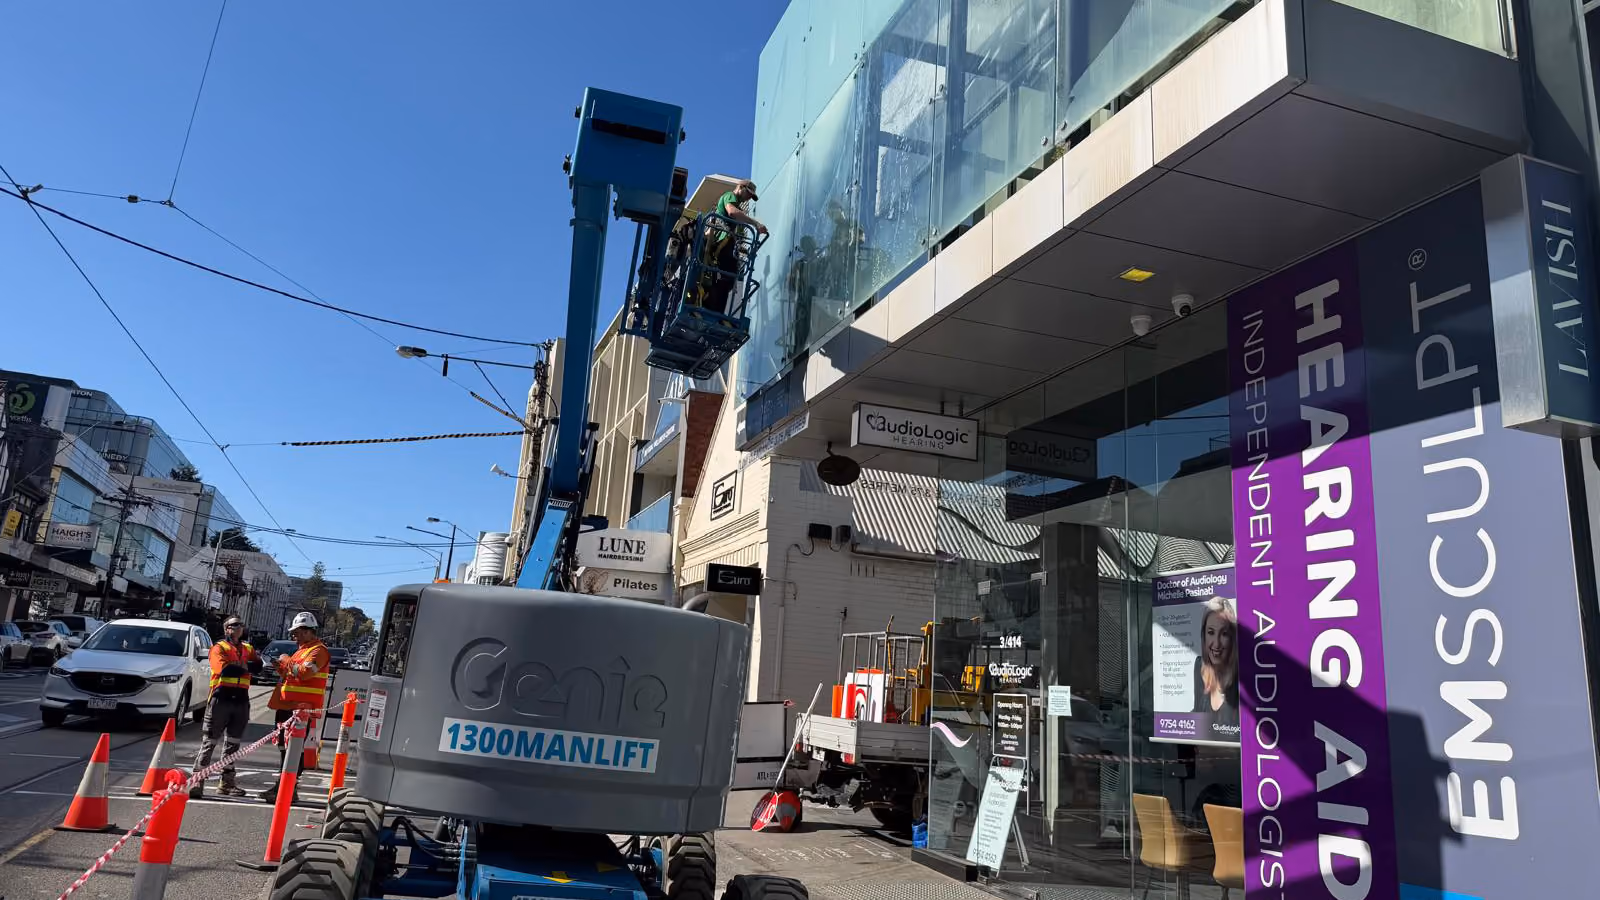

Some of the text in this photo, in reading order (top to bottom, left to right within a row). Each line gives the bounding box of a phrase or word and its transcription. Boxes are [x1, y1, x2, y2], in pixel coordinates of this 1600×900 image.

[1541, 196, 1590, 380] LAVISH
[893, 435, 945, 450] HEARING
[52, 527, 92, 539] HAIGH'S
[598, 537, 647, 555] LUNE
[598, 553, 644, 562] HAIRDRESSING
[613, 578, 658, 591] Pilates
[1157, 573, 1228, 590] Doctor of Audiology
[1295, 279, 1373, 900] HEARING AID
[1157, 585, 1214, 601] Michelle Pasinati
[1243, 310, 1286, 900] INDEPENDENT AUDIOLOGIS
[999, 635, 1022, 649] 3/414
[451, 637, 668, 729] Genie
[999, 676, 1022, 684] HEARING
[1160, 719, 1196, 730] 9754 4162
[447, 723, 655, 770] 1300MANLIFT
